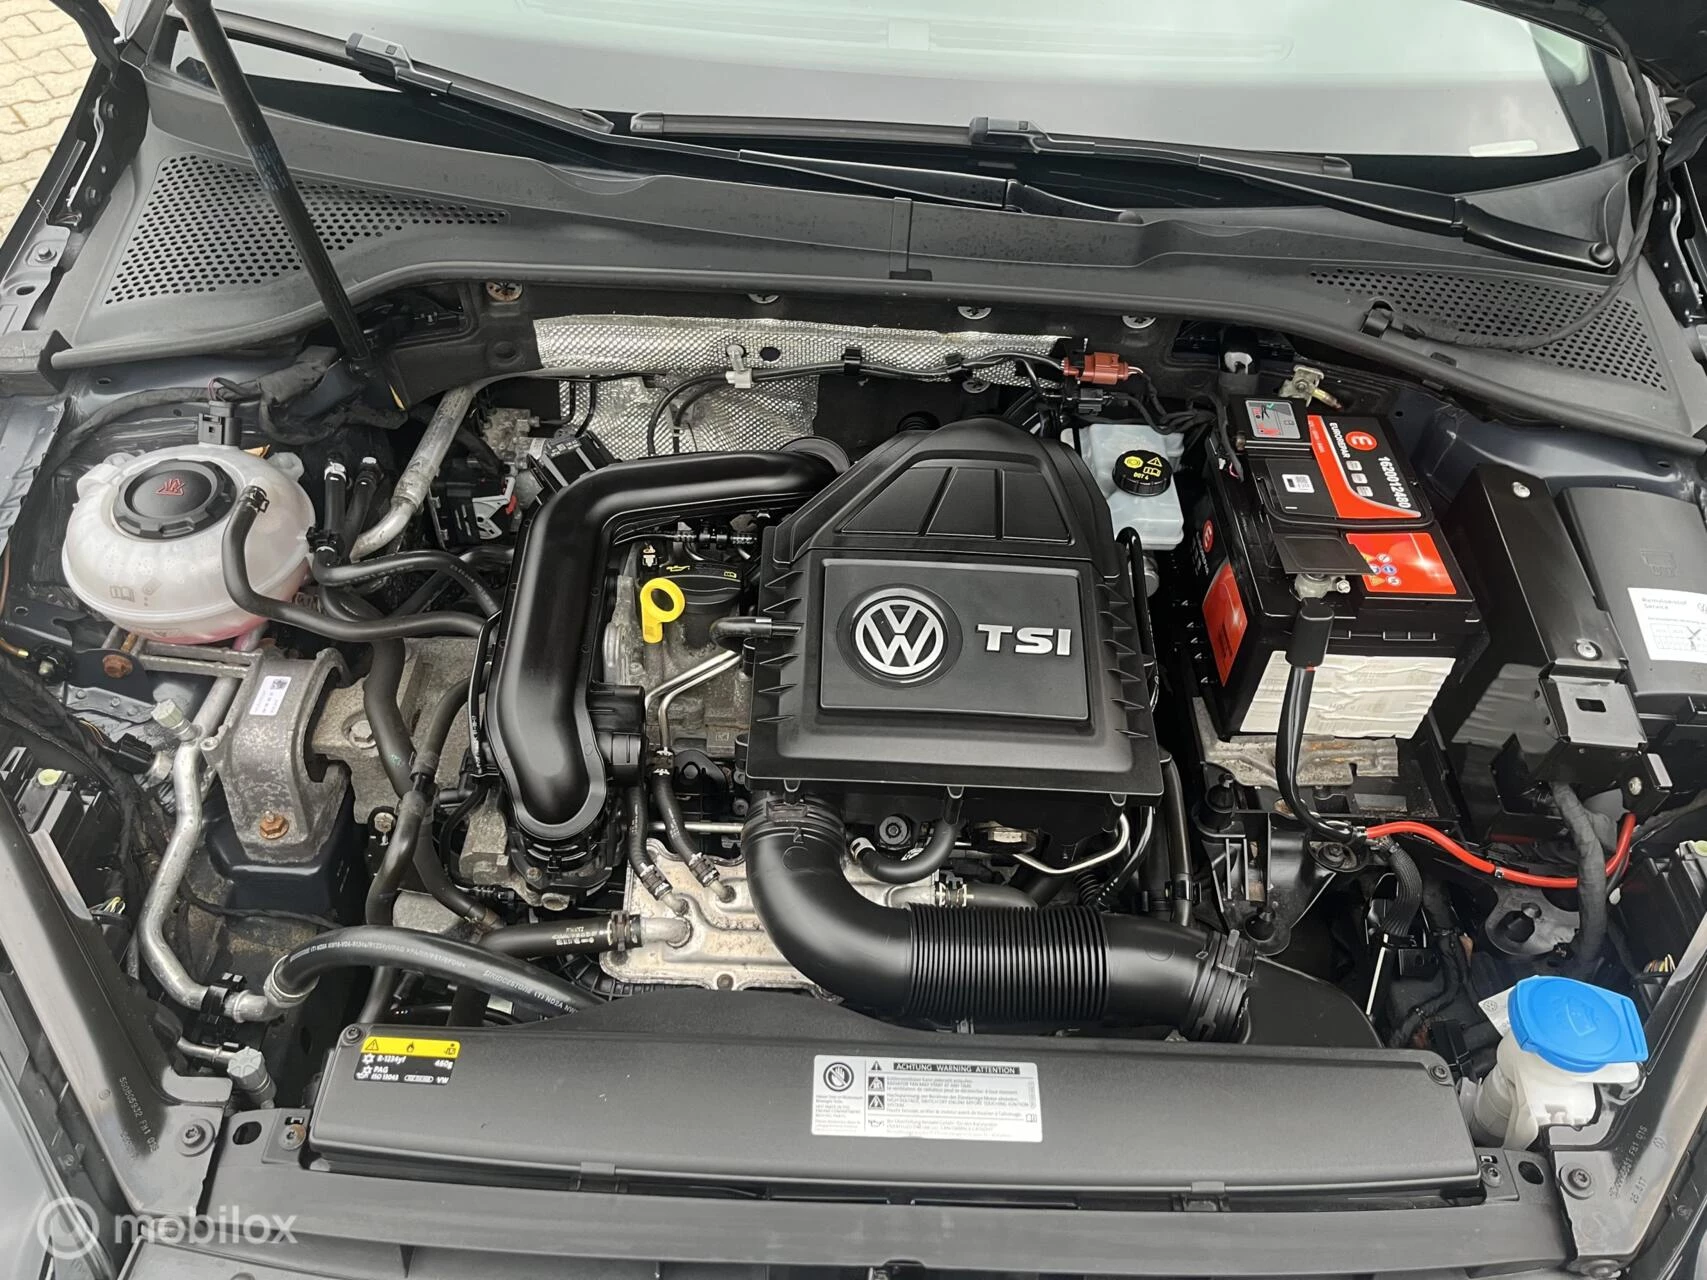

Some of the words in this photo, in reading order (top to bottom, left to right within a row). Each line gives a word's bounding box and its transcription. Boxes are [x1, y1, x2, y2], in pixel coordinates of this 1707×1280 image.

[1329, 422, 1351, 459] EUROREPAR
[1378, 456, 1412, 509] 1620012480
[976, 623, 1072, 656] TSI
[373, 1066, 389, 1074] PAG
[896, 1063, 933, 1072] ACHTUNG
[936, 1064, 972, 1073] WARNING
[975, 1065, 1016, 1074] ATTENTION
[436, 1076, 449, 1084] VW
